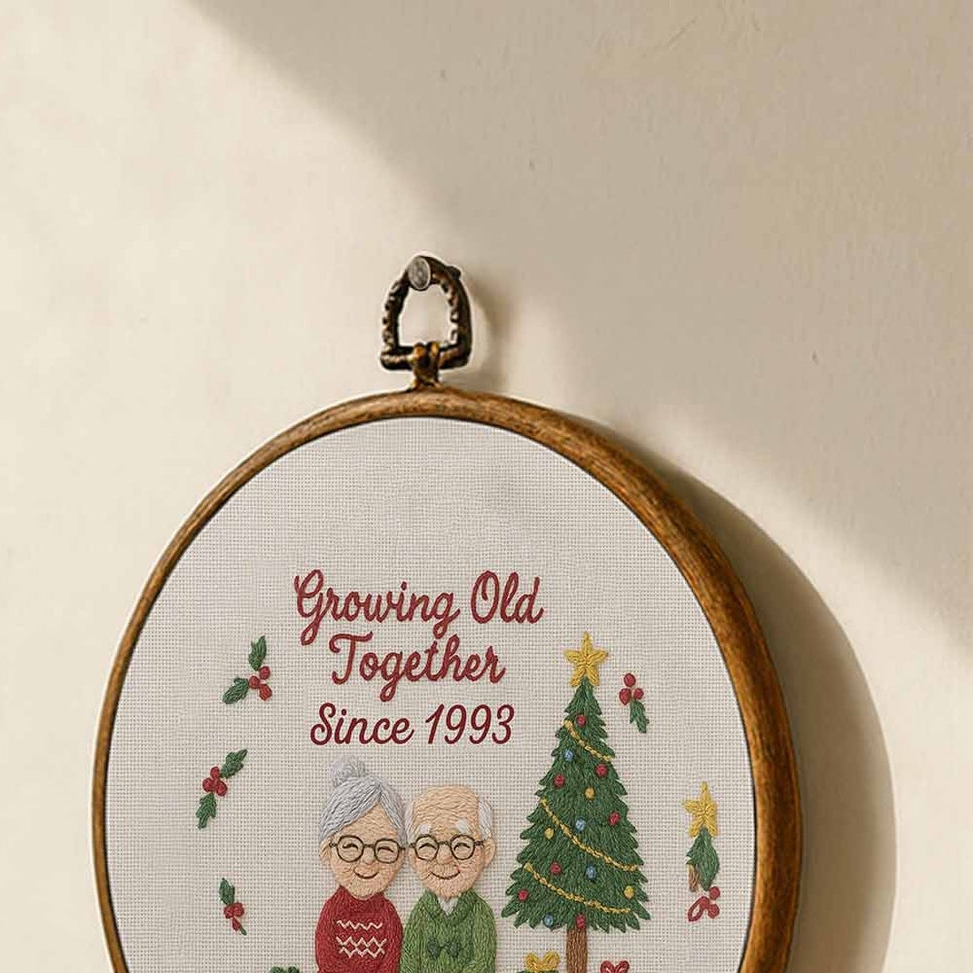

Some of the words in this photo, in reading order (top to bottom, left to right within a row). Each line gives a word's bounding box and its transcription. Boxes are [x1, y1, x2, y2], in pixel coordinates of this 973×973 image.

[294, 569, 460, 646] Growing
[470, 570, 544, 624] Old
[329, 632, 506, 702] Together
[310, 702, 415, 745] Since
[425, 703, 515, 745] 1993
